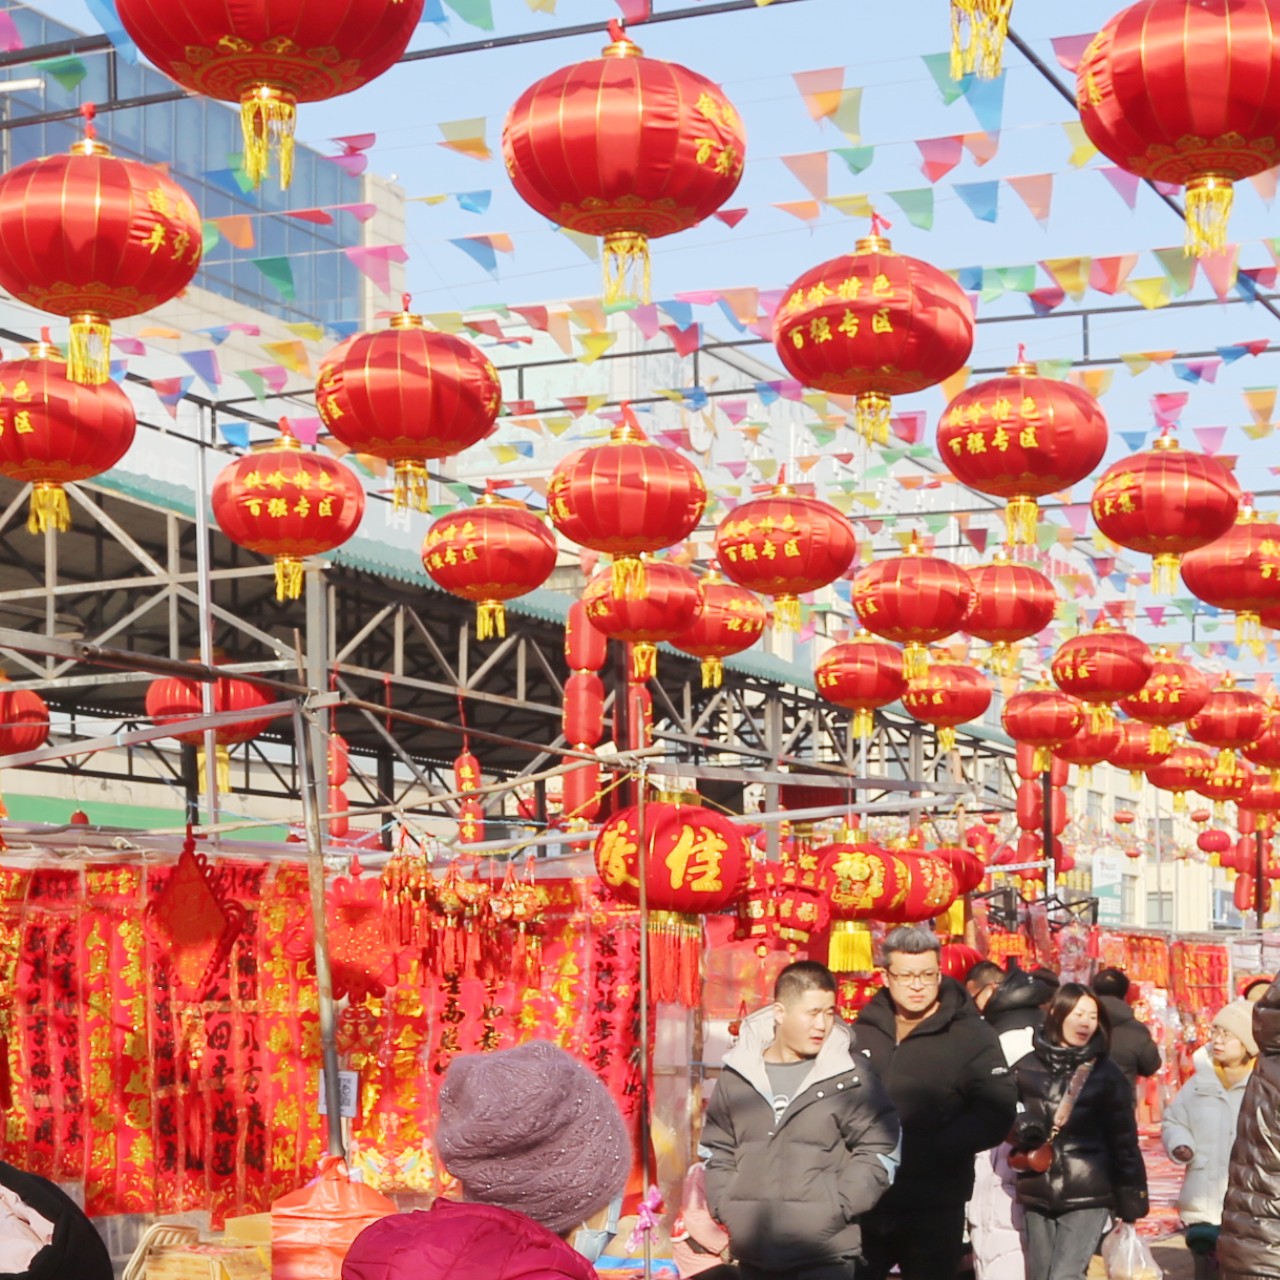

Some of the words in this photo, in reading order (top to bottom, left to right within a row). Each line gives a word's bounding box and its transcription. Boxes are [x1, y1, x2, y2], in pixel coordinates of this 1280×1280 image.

[786, 274, 894, 312] 铁岭特色
[787, 308, 894, 349] 百强专区
[948, 396, 1040, 427] 铁岭特色
[948, 427, 1040, 456] 百强专区
[245, 497, 334, 519] 百强专区
[724, 539, 801, 563] 百强专区
